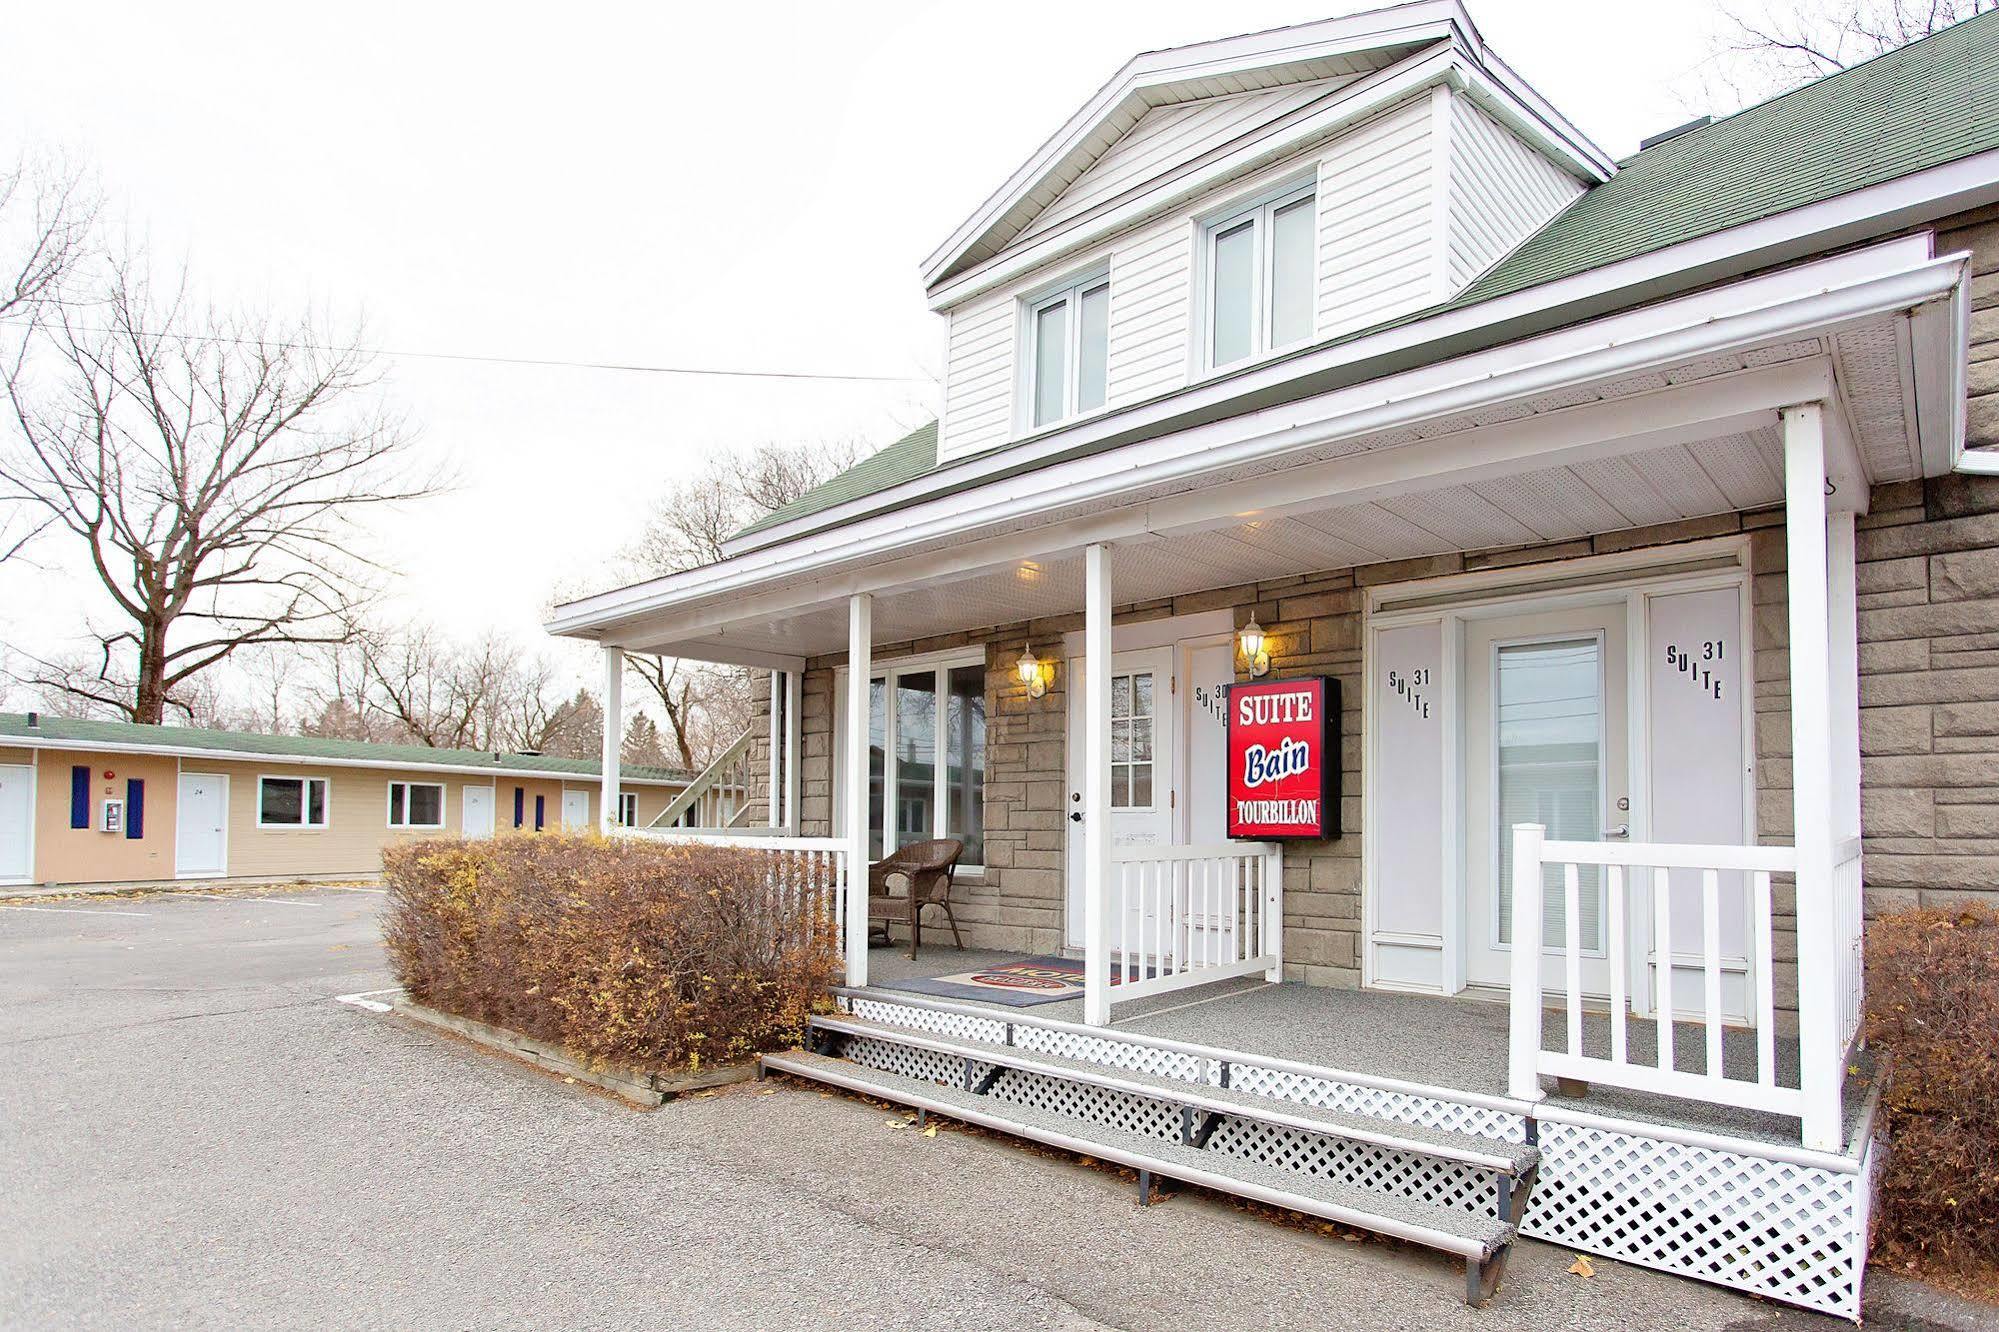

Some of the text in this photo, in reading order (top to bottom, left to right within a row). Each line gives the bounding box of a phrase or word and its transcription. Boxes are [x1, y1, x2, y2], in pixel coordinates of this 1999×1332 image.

[1389, 669, 1429, 719] SUITE 31
[1667, 641, 1724, 699] SUITE 31
[1239, 692, 1313, 726] SUITE
[1245, 738, 1309, 786] Bain
[1237, 799, 1317, 825] TOURBILLON
